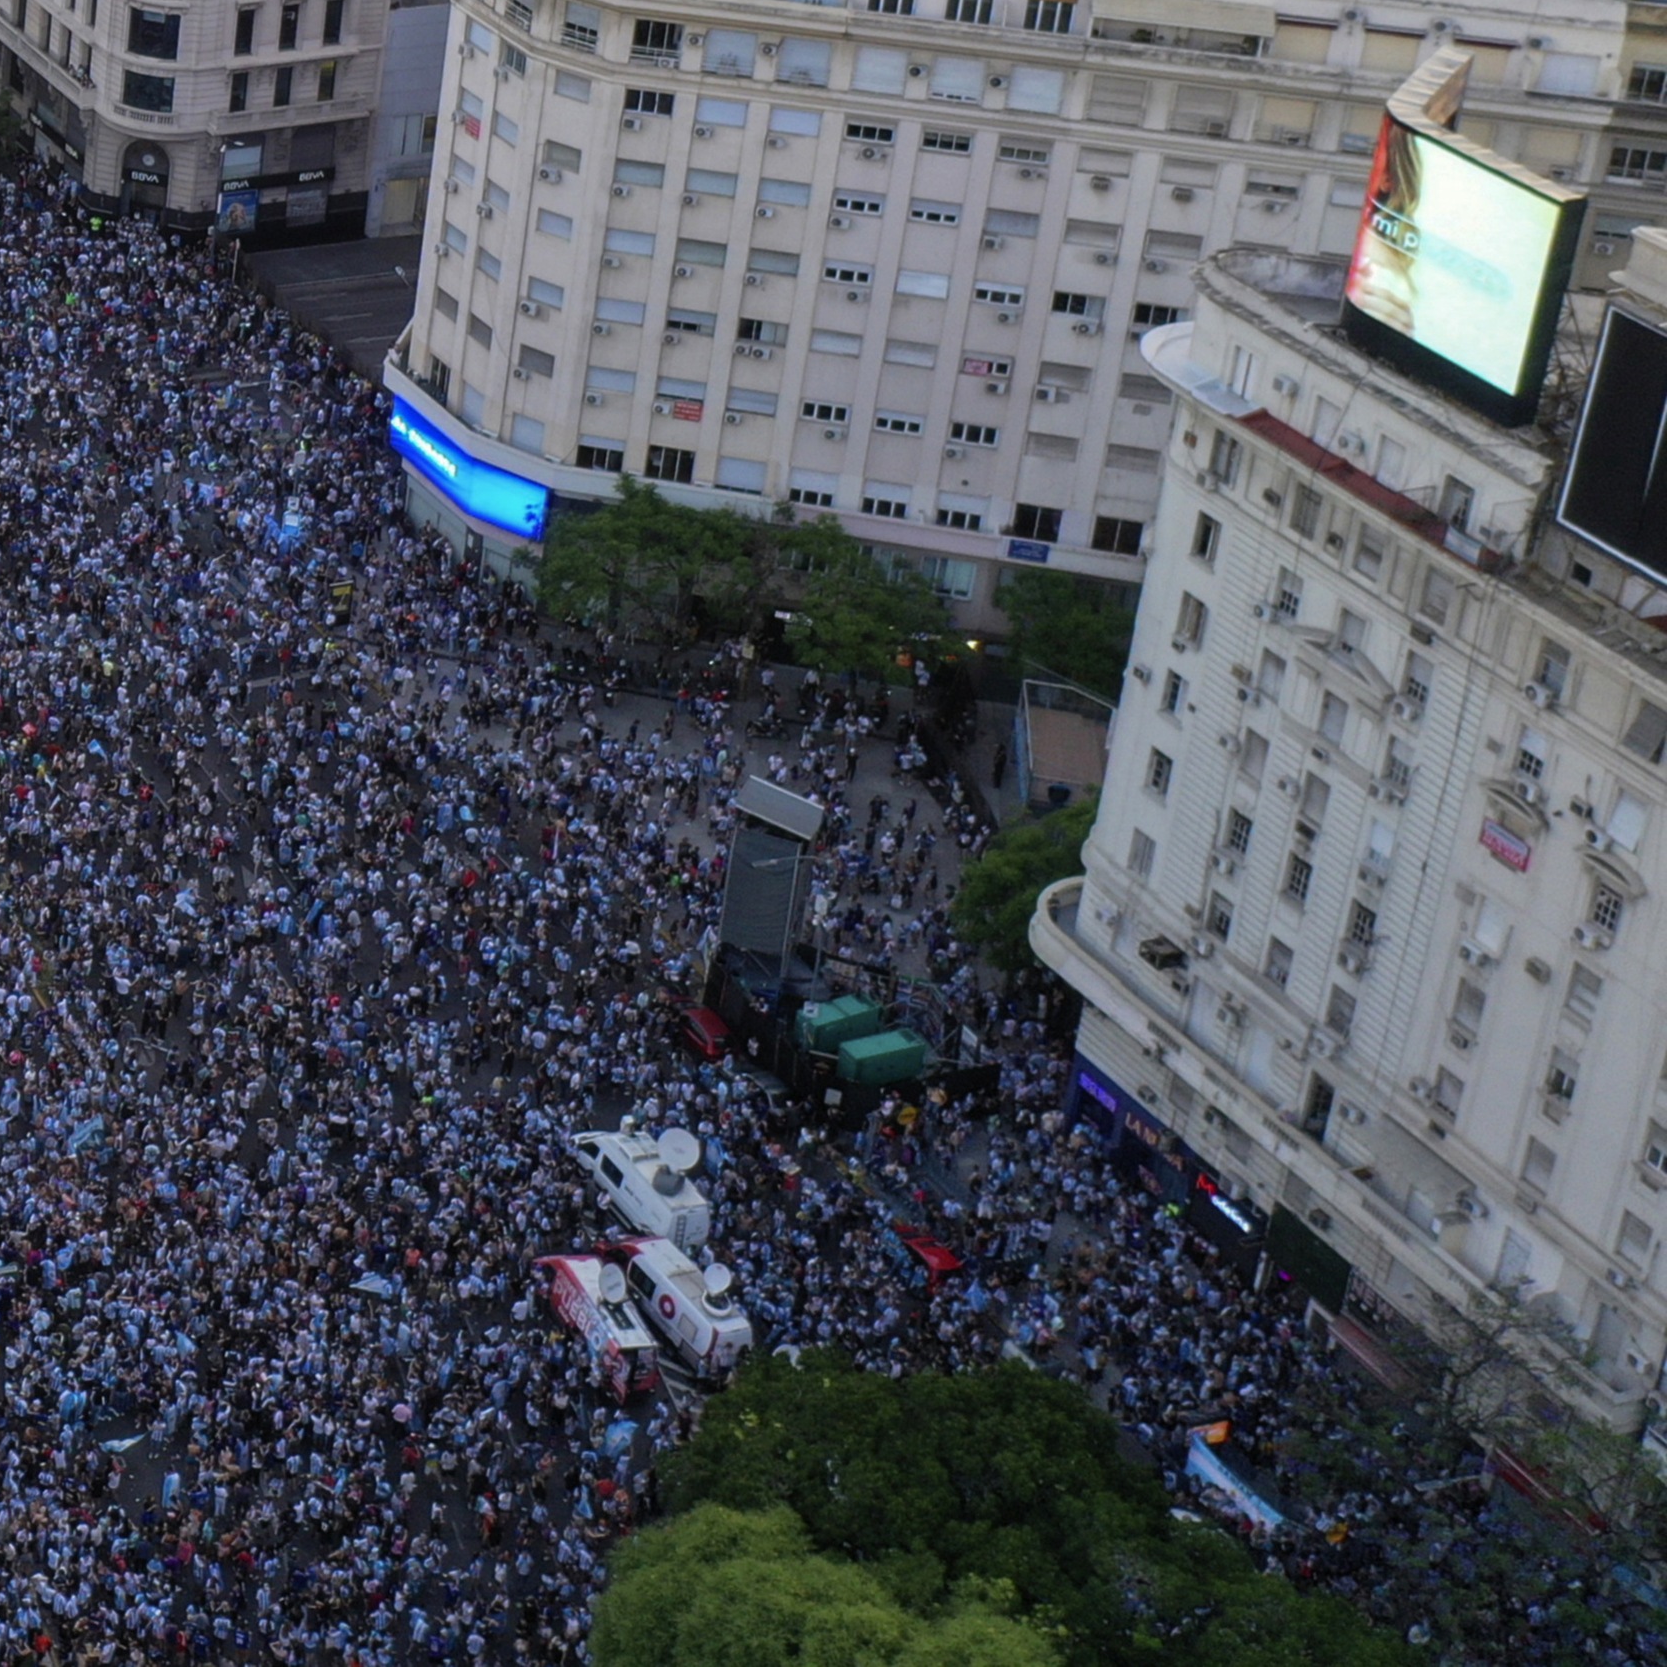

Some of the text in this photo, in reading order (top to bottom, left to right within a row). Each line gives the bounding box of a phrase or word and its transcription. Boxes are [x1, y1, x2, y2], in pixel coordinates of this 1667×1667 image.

[131, 171, 159, 183] BBVA
[299, 170, 325, 182] BBVA
[223, 179, 250, 191] BBVA
[1371, 214, 1399, 237] mi
